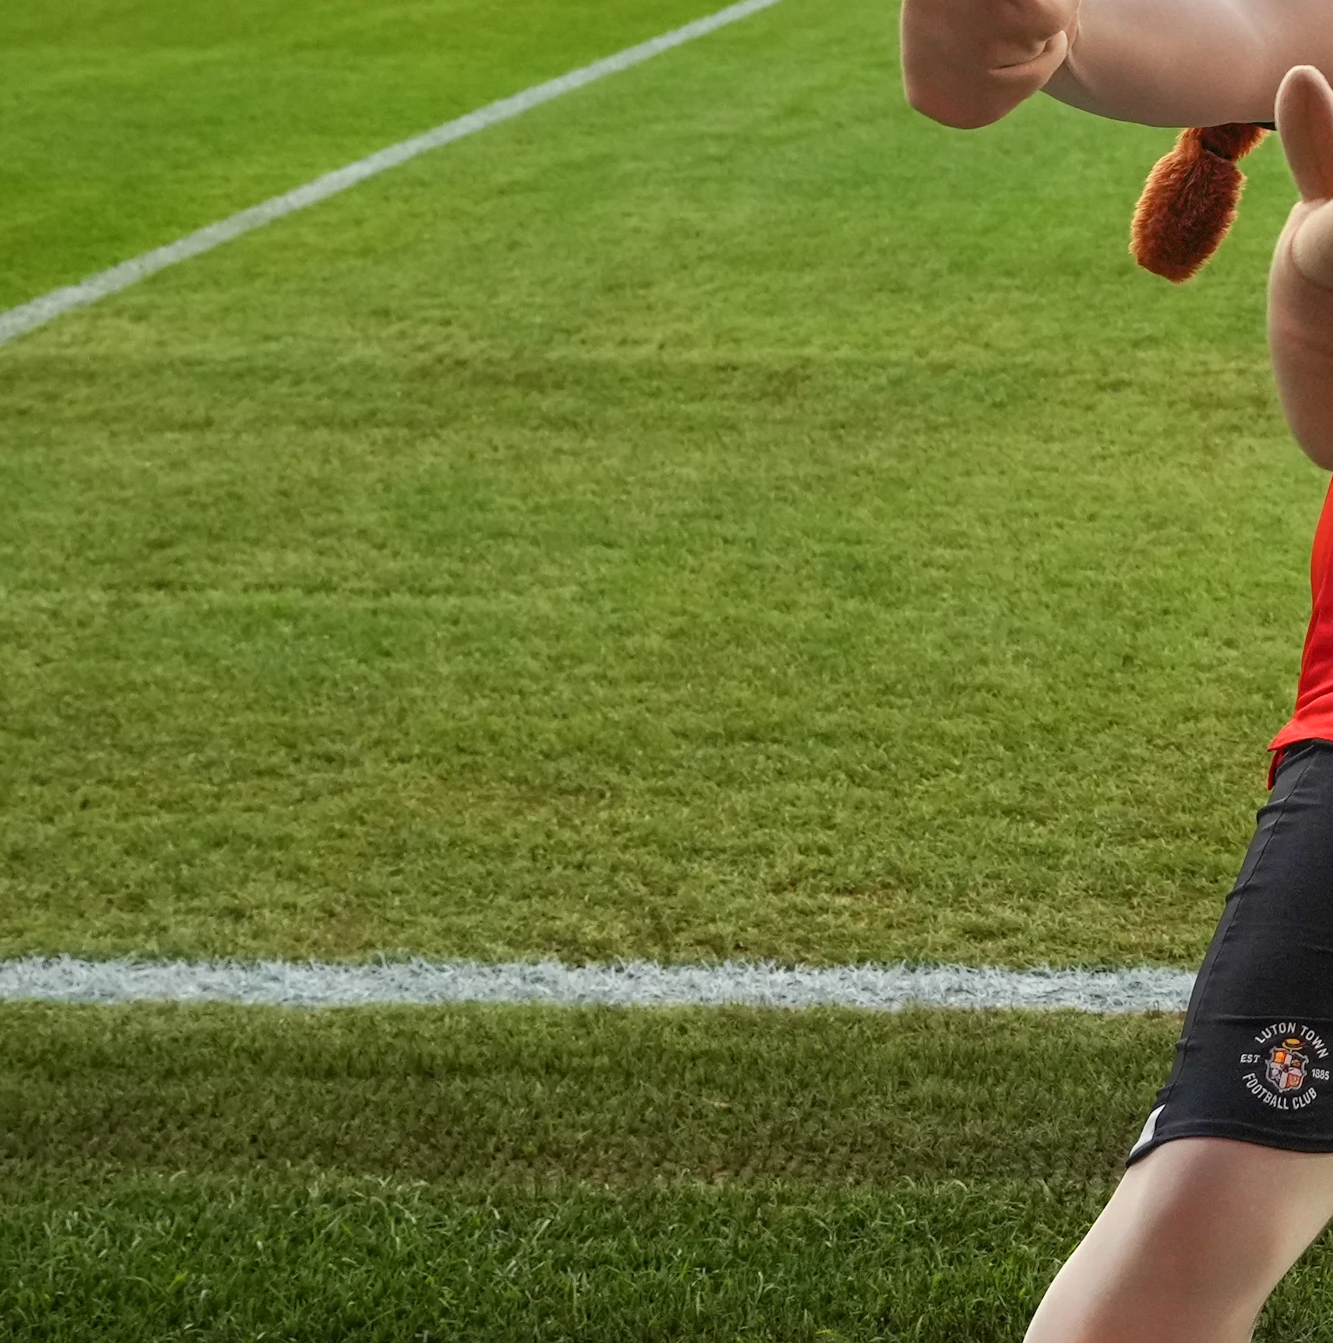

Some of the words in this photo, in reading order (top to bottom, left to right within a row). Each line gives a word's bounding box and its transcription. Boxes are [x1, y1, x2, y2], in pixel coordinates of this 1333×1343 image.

[1255, 1022, 1296, 1044] LUTON
[1301, 1025, 1329, 1058] TOWN
[1240, 1053, 1260, 1064] EST
[1312, 1068, 1330, 1080] 1885
[1242, 1072, 1289, 1110] FOOTBALL
[1292, 1087, 1317, 1110] CLUB
